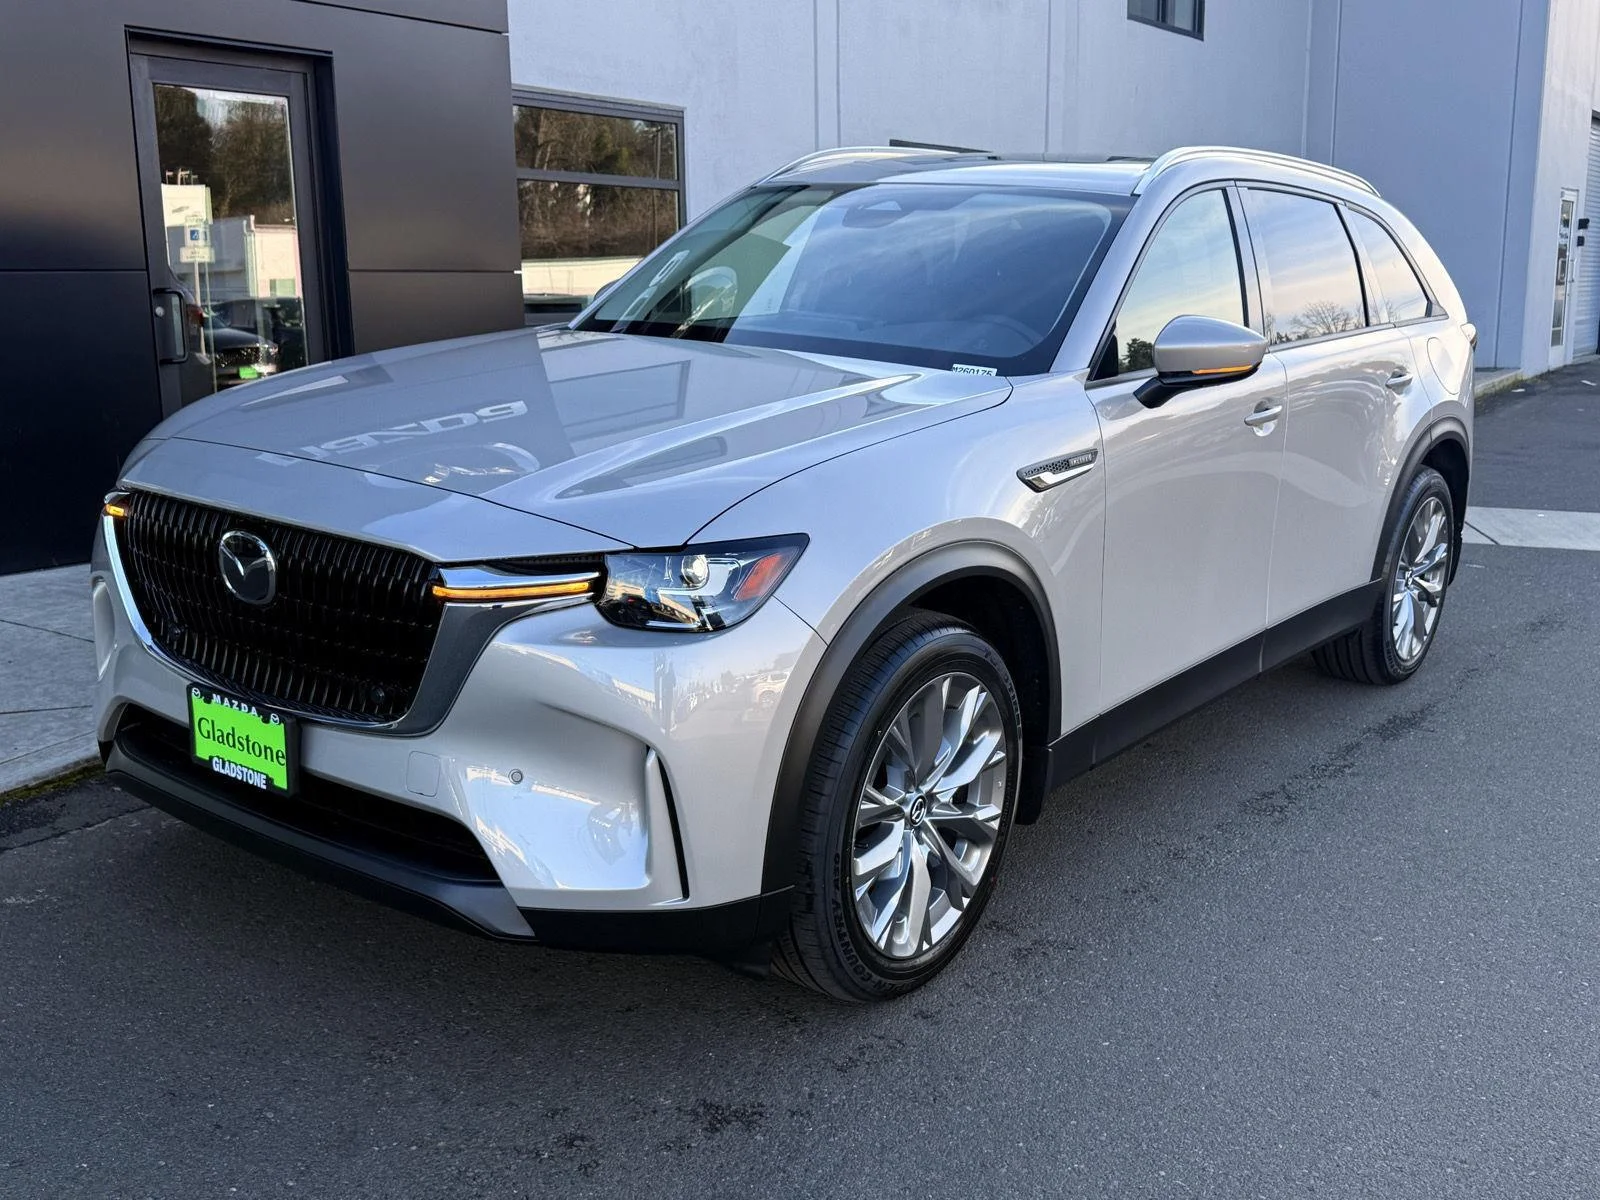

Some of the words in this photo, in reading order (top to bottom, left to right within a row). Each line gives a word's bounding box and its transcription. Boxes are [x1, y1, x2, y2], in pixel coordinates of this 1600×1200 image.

[212, 693, 258, 717] MAZDA
[197, 717, 285, 766] Gladstone
[212, 757, 267, 790] GLADSTONE
